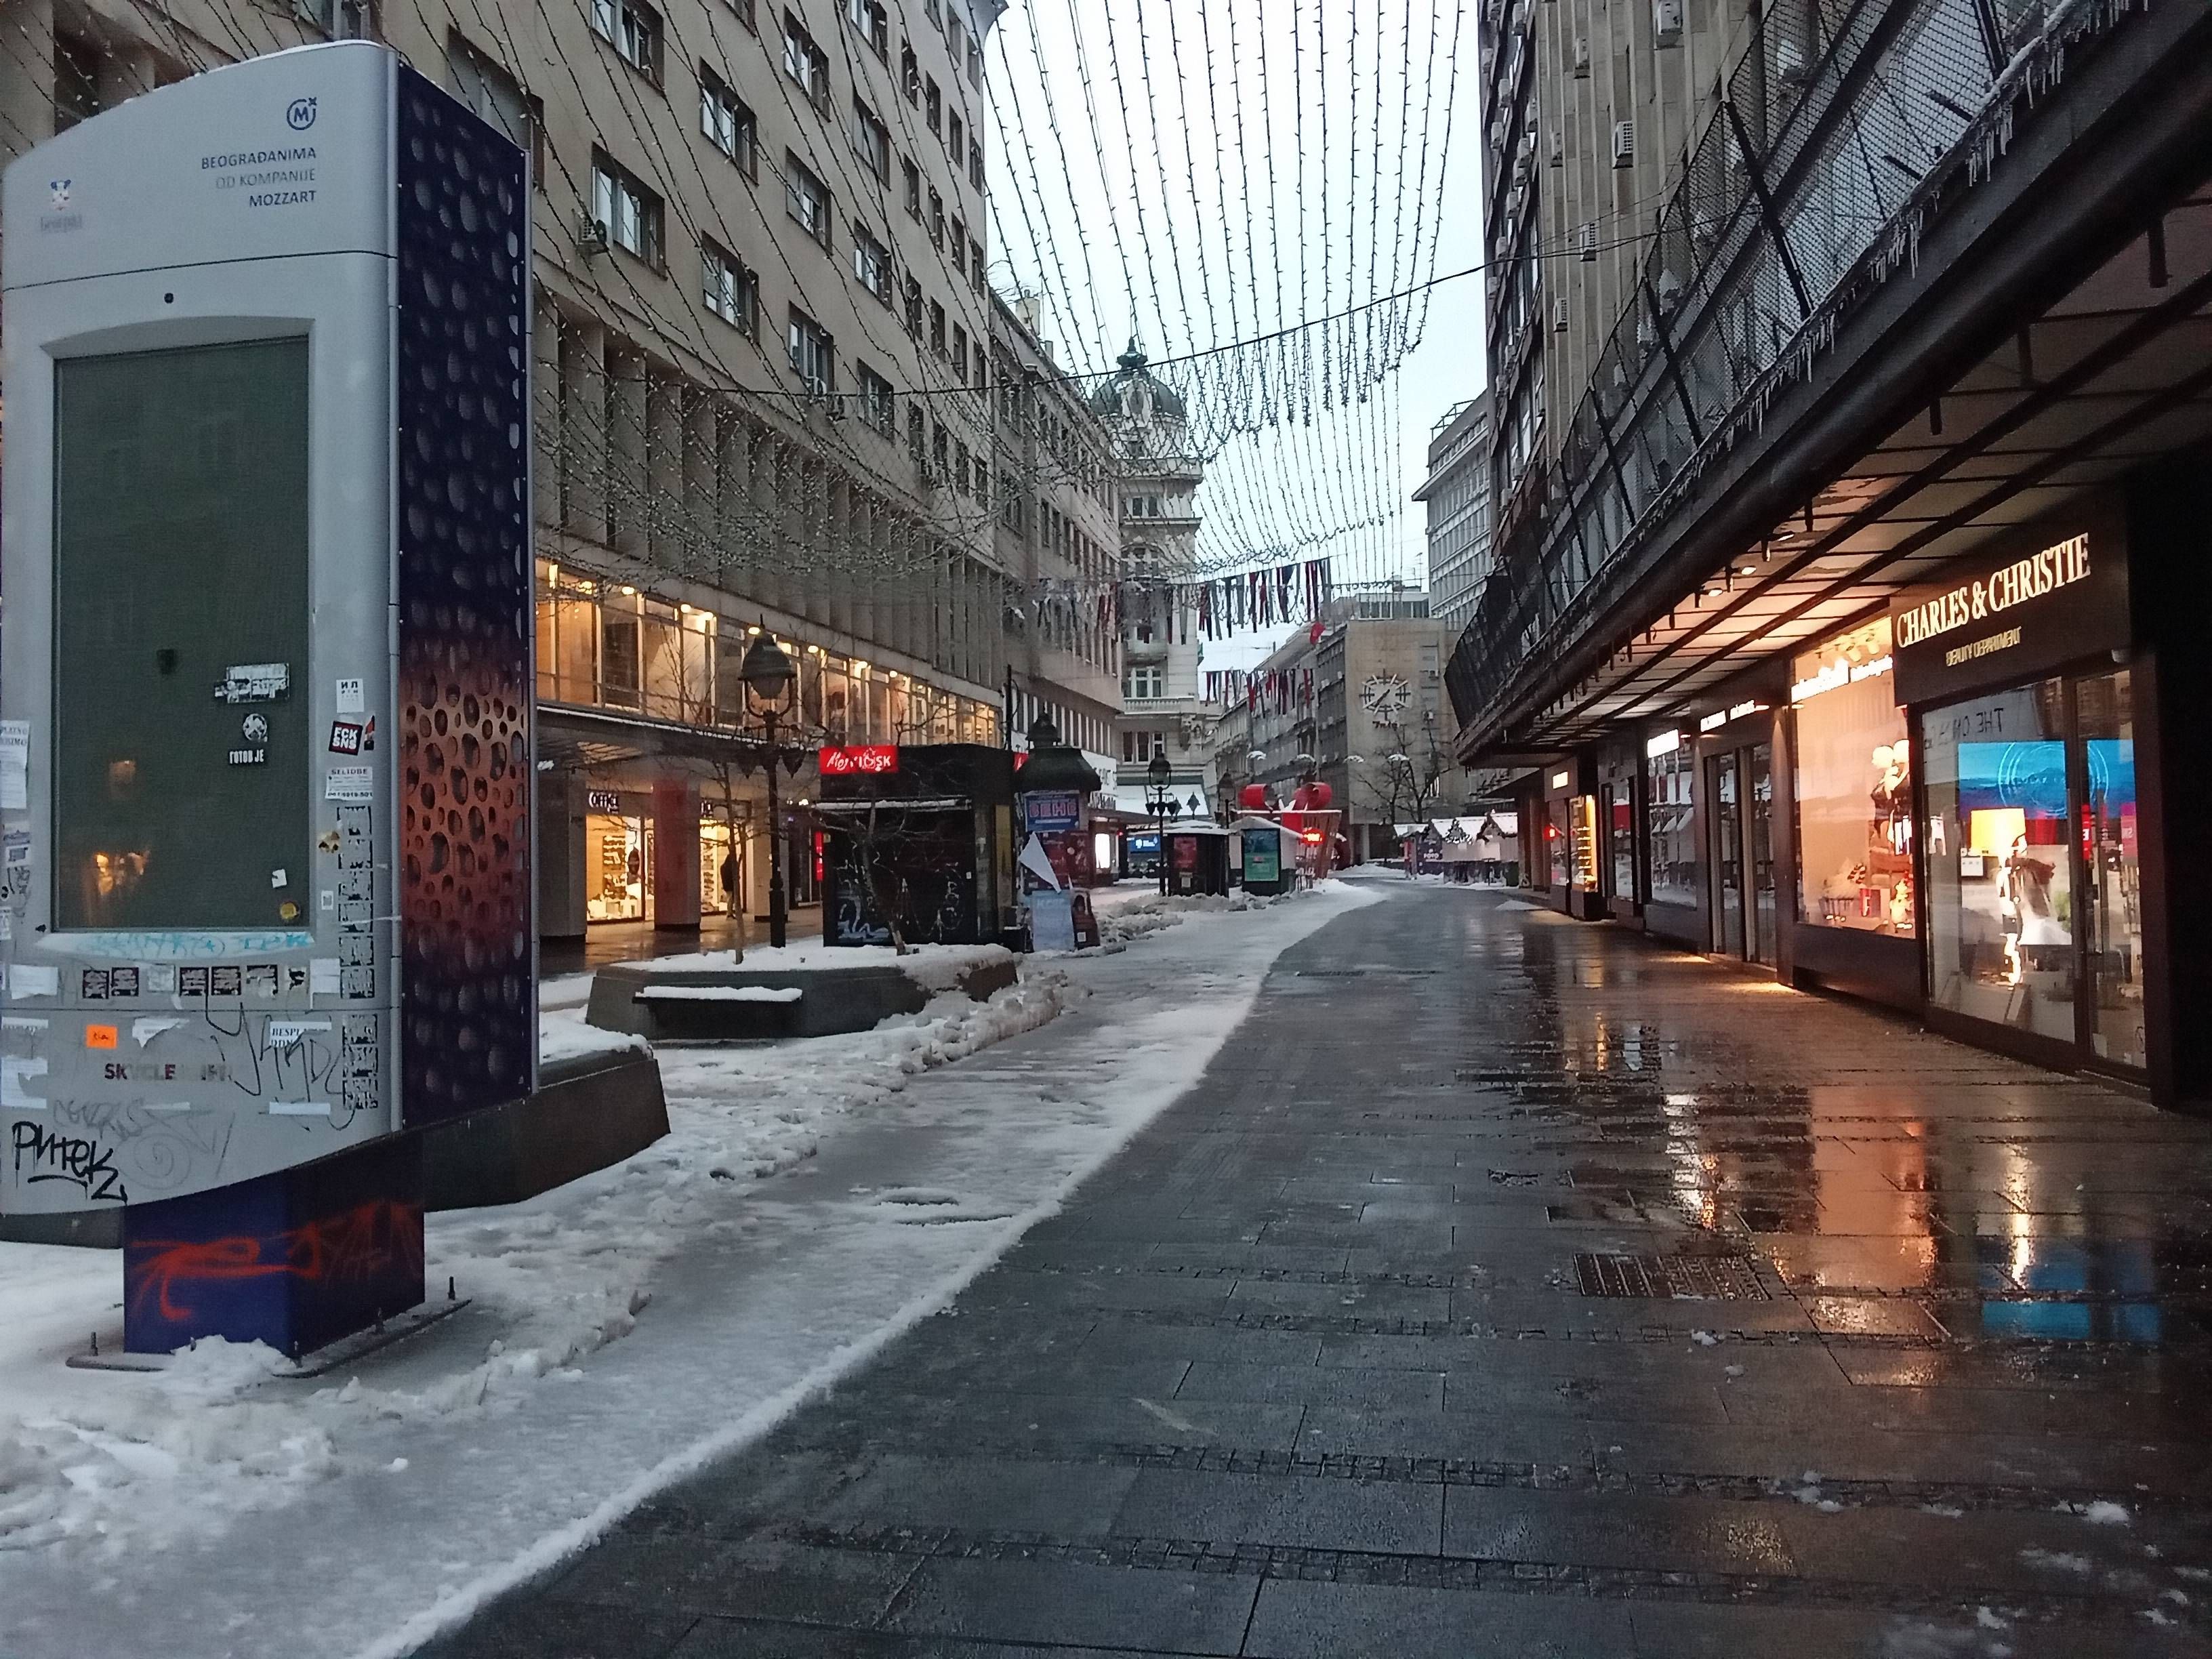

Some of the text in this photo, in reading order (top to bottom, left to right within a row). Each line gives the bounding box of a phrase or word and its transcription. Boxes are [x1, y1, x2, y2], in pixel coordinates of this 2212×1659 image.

[201, 147, 316, 169] BEOGRAĐANIMA
[216, 169, 316, 190] OD KOMPANIJE
[249, 190, 316, 207] MOZZART
[1897, 532, 2091, 648] CHARLES & CHRISTIE
[1946, 626, 2022, 667] BEAUTY DEPARTMENT
[334, 727, 359, 741] FCK
